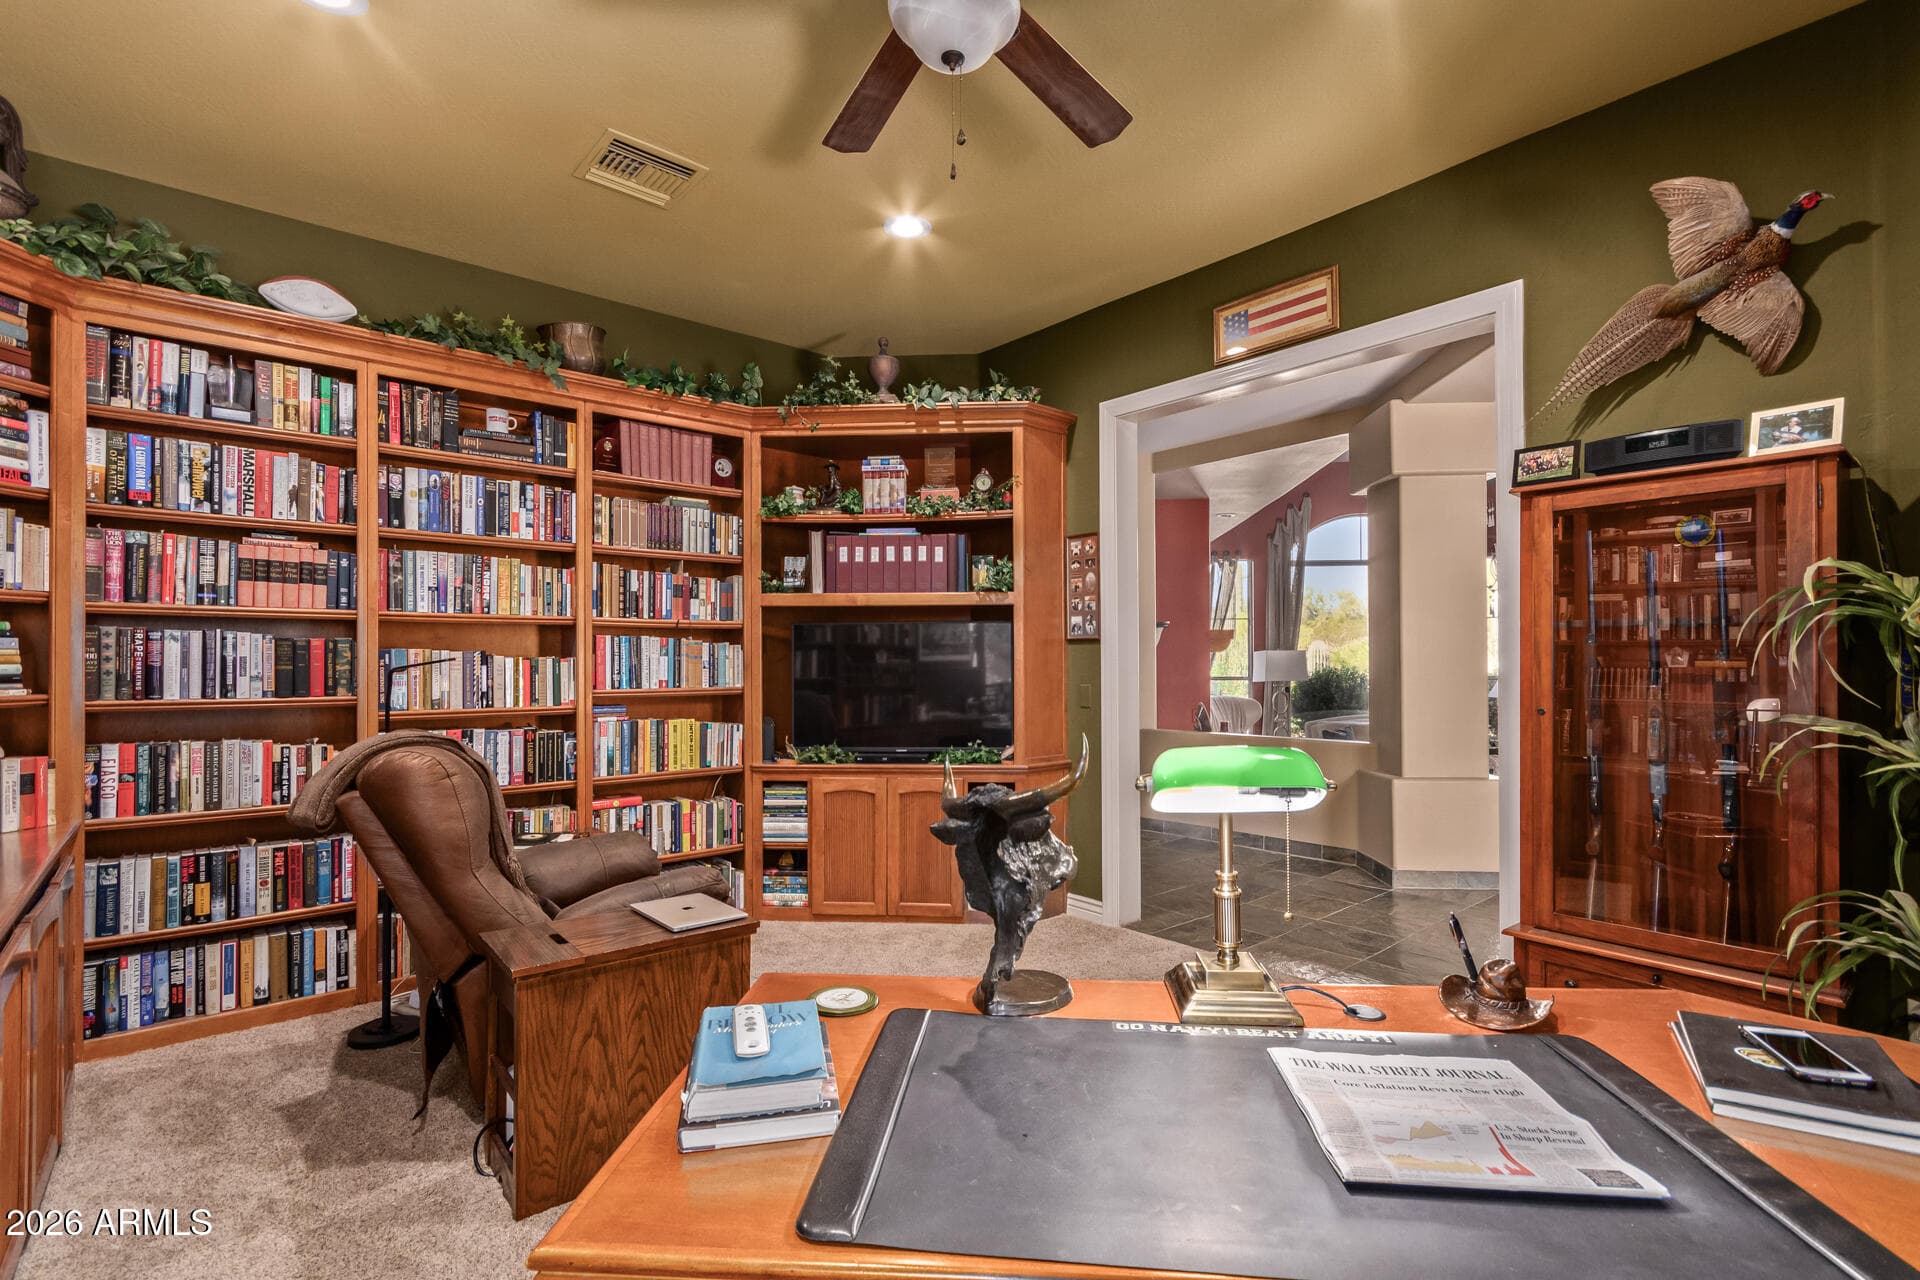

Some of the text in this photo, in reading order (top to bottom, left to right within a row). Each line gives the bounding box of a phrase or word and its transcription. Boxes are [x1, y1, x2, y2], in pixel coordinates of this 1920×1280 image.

[108, 450, 118, 495] OF BATTLE
[117, 456, 126, 492] THE DAY
[136, 479, 146, 490] WAR
[192, 448, 210, 500] Eisenhower
[243, 449, 255, 515] MARSHALL
[134, 633, 144, 657] RAPE
[101, 758, 117, 800] FIASCO
[274, 851, 285, 876] PRIZE
[106, 887, 115, 927] LINDBERGH
[1115, 1022, 1392, 1043] GO NAVY! BEAT ARMY!
[1289, 1057, 1511, 1080] THE WALL STREET JOURNAL.
[1333, 1080, 1361, 1088] Core
[1364, 1082, 1417, 1092] Inflation
[1420, 1085, 1447, 1093] Revs
[1494, 1088, 1524, 1098] High
[1499, 1132, 1586, 1145] In Sharp Reversal
[1516, 1125, 1550, 1134] Stocks
